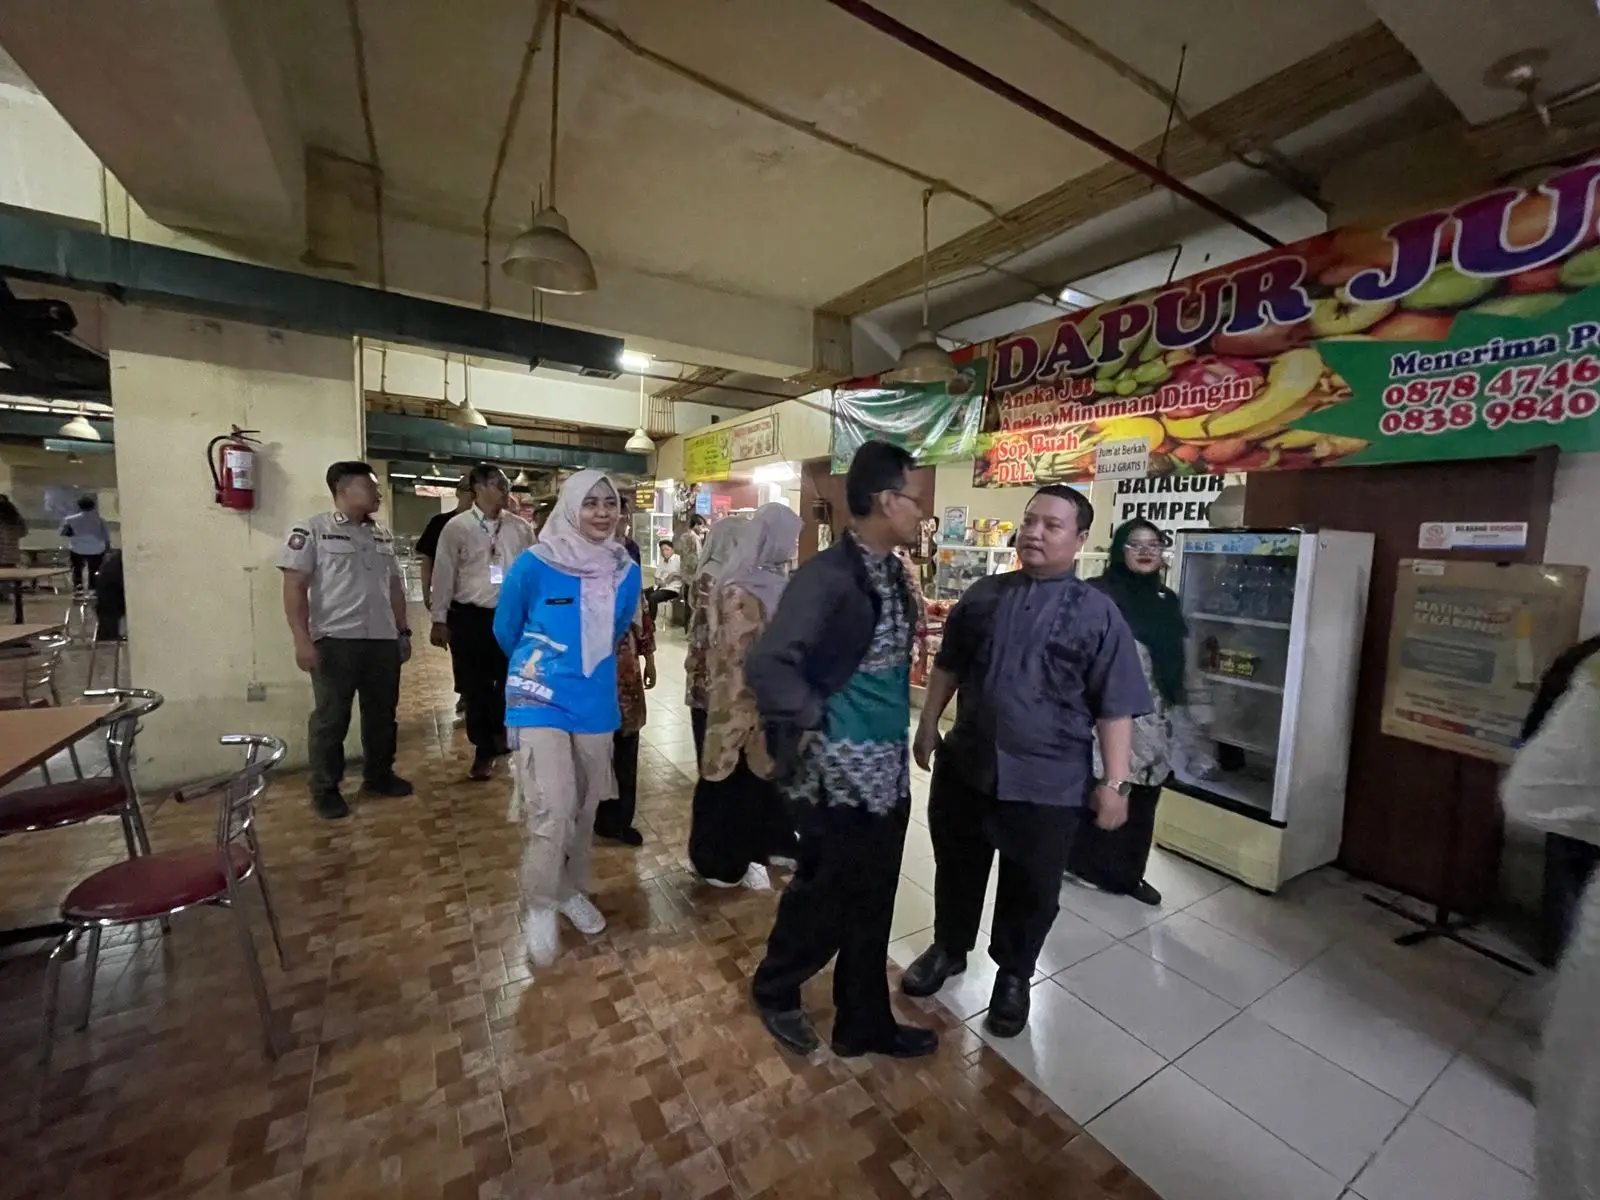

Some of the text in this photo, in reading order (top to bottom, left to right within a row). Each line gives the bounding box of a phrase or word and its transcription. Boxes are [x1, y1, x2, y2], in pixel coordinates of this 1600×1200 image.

[992, 255, 1315, 391] DAPUR
[1389, 322, 1600, 378] Menerima P
[1000, 378, 1095, 410] Aneka Jus
[1382, 355, 1600, 408] 0878 4746
[1001, 377, 1253, 433] Aneka Minuman Dingin
[1379, 389, 1599, 435] 0838 9840
[998, 430, 1079, 460] Sop Buah
[1121, 442, 1146, 455] Berkah
[1097, 463, 1111, 474] BELI
[1112, 462, 1116, 473] 2
[1117, 460, 1141, 472] GRATIS
[1122, 501, 1209, 520] PEMPEK
